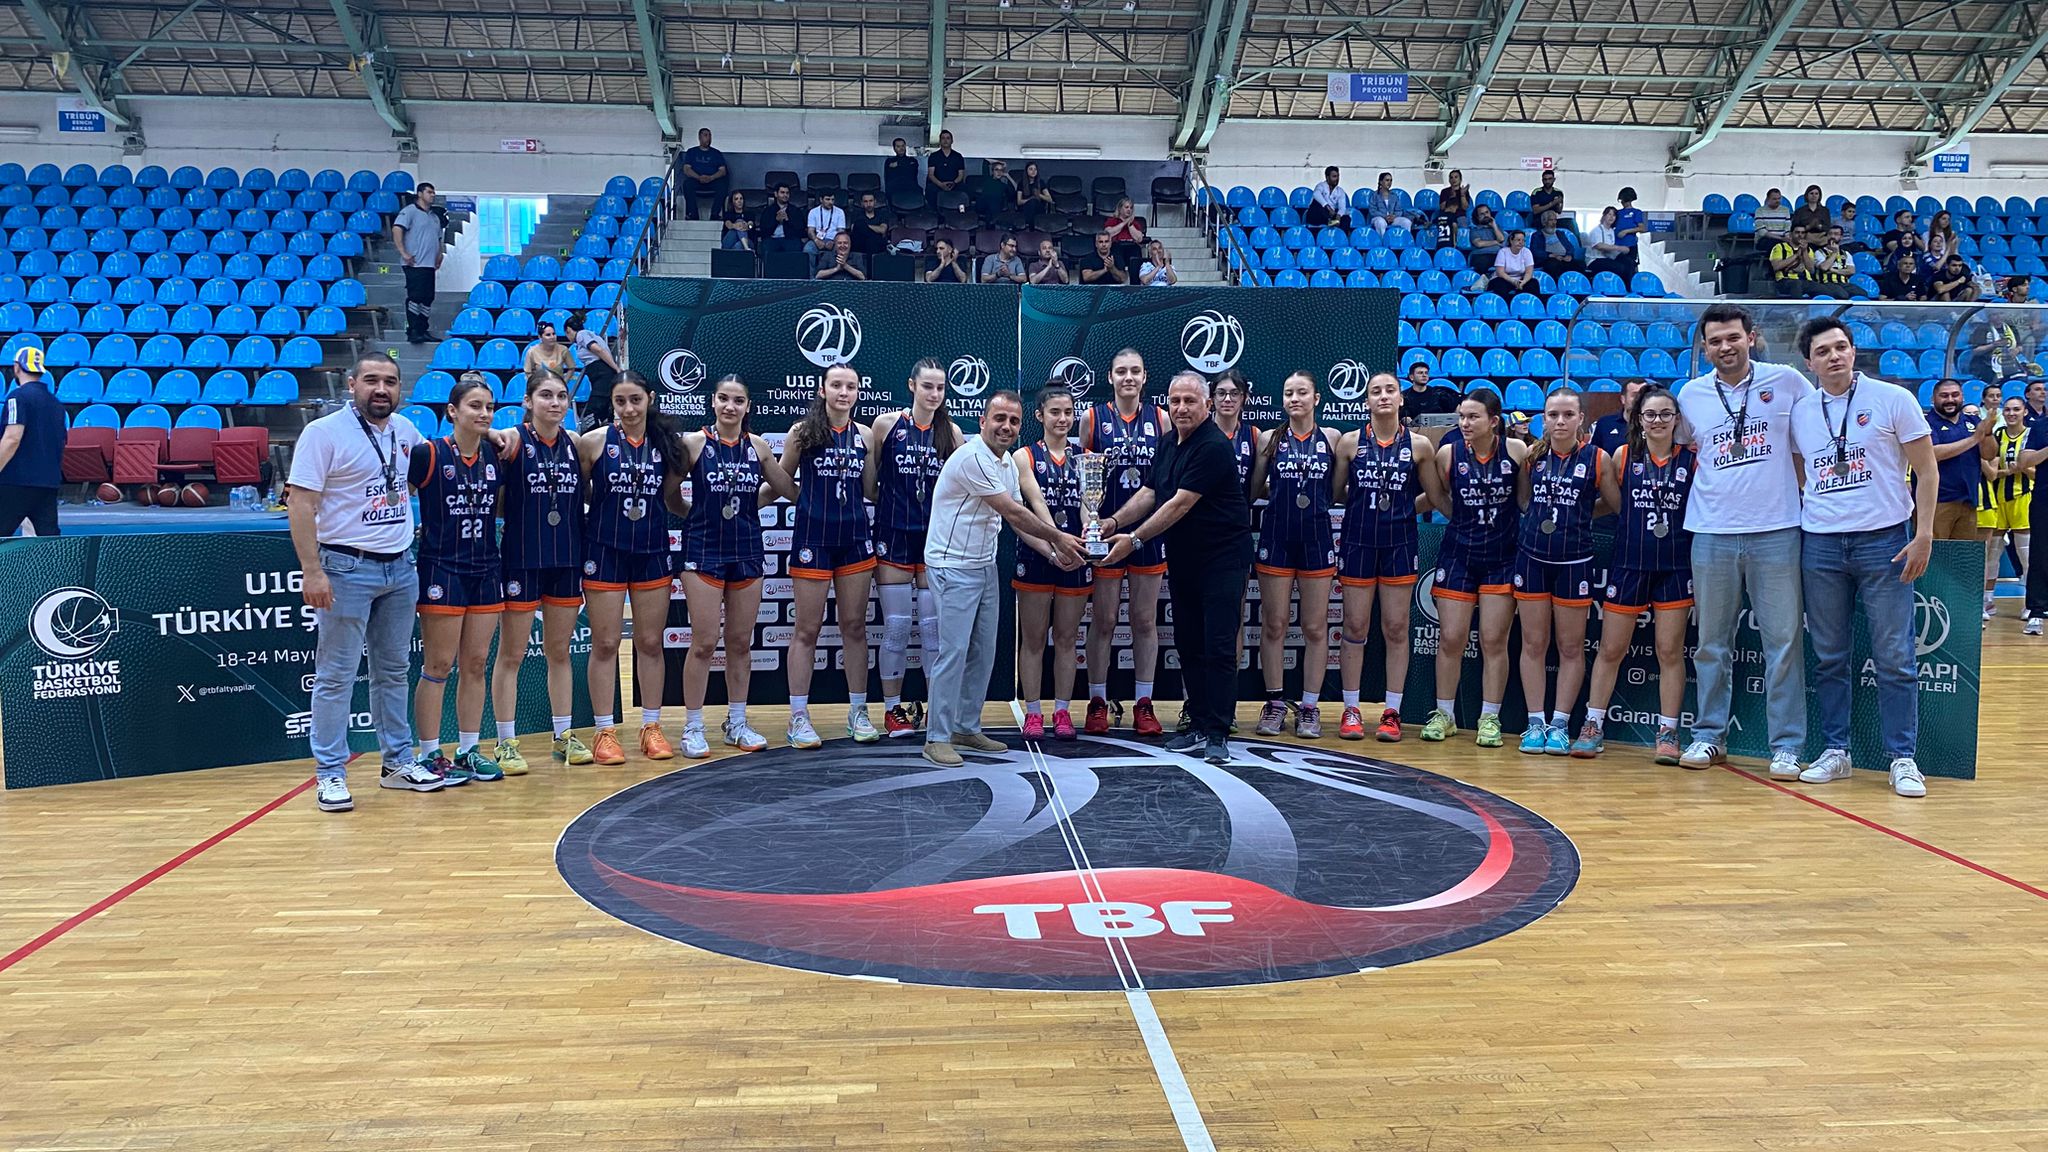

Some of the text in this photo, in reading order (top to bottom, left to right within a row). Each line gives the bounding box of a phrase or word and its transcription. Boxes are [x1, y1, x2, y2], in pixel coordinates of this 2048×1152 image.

[1361, 75, 1403, 85] TRİBÜN
[64, 112, 98, 120] TRİBÜN
[1438, 225, 1450, 236] 21
[786, 376, 815, 388] U16
[660, 392, 706, 404] TÜRKİYE
[766, 388, 814, 400] TÜRKİYE
[756, 406, 786, 414] 18-24
[1242, 409, 1282, 420] EDİRNE
[1814, 446, 1866, 468] ESKİEHİR
[1820, 460, 1864, 480] ÇAAŞ
[706, 472, 759, 486] ÇADAŞ
[1120, 469, 1141, 488] 46
[1814, 470, 1872, 491] KOLEJLİLER
[1533, 484, 1580, 500] ÇADAŞ
[623, 498, 647, 518] 99
[462, 518, 482, 538] 22
[246, 570, 303, 595] U16
[152, 602, 293, 636] TÜRKİYE
[217, 649, 315, 667] 18-24 Mayı
[33, 658, 120, 680] TÜRKİYE
[34, 674, 121, 690] BASKETBOL
[34, 684, 121, 699] FEDERASYONU
[973, 902, 1234, 939] TBF
